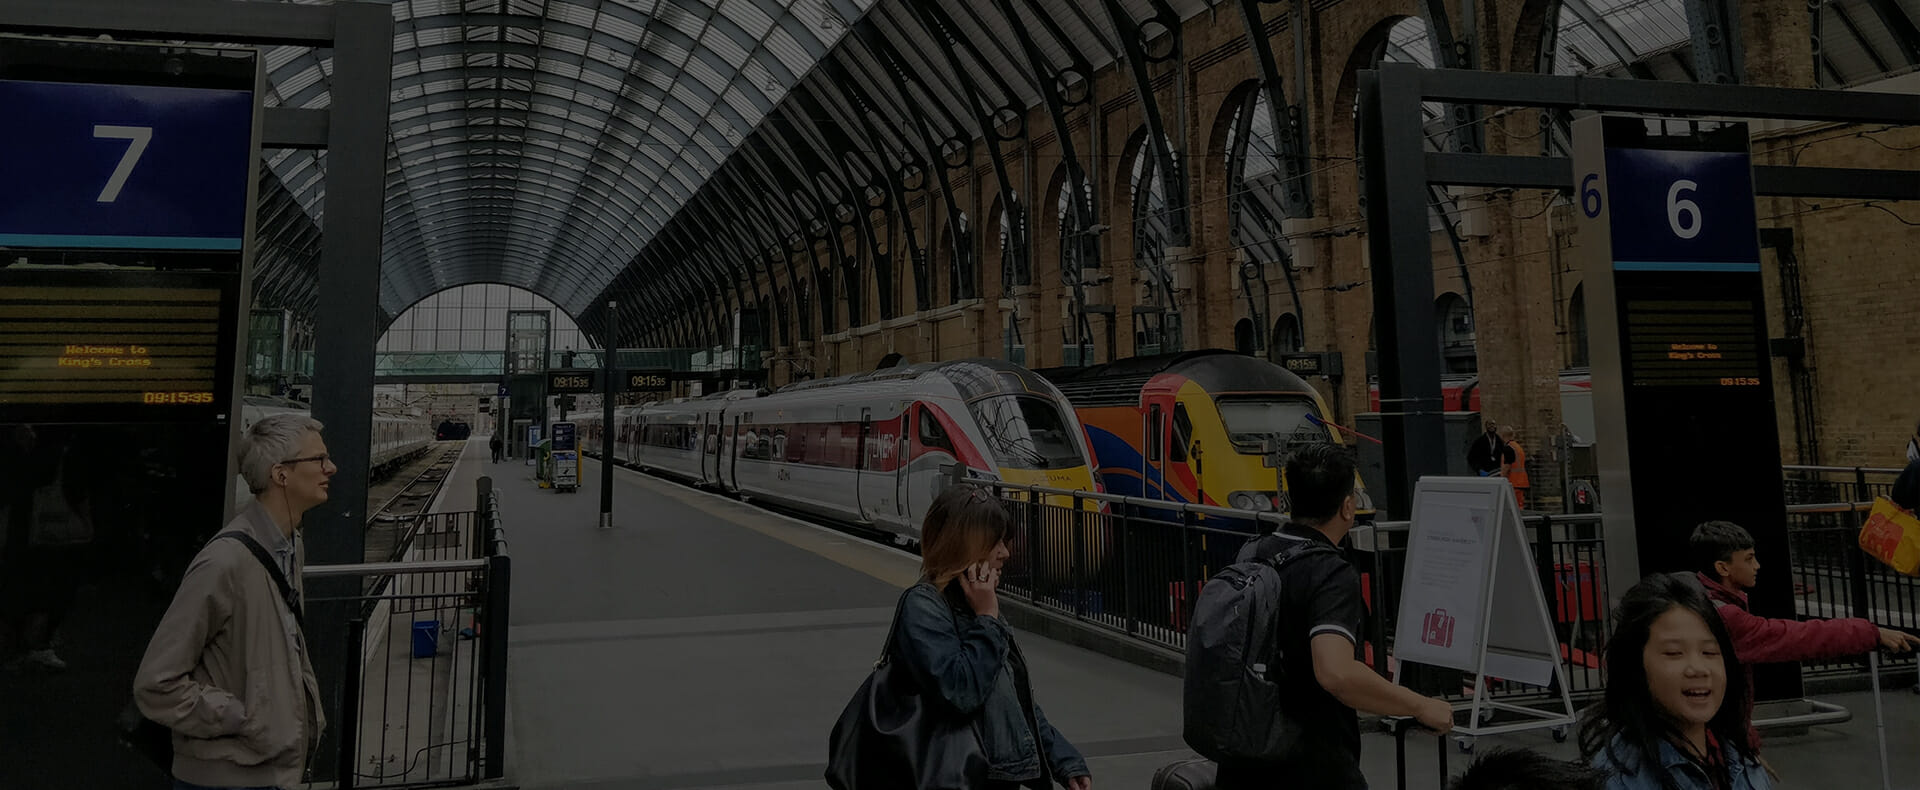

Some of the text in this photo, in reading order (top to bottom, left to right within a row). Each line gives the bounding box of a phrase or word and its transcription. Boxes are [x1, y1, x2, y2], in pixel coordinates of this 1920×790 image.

[93, 125, 153, 203] 7
[1582, 173, 1602, 218] 6
[1666, 179, 1702, 239] 6
[58, 356, 152, 368] King's Cross
[65, 345, 147, 355] Welcome to
[143, 390, 214, 404] 09:15:35
